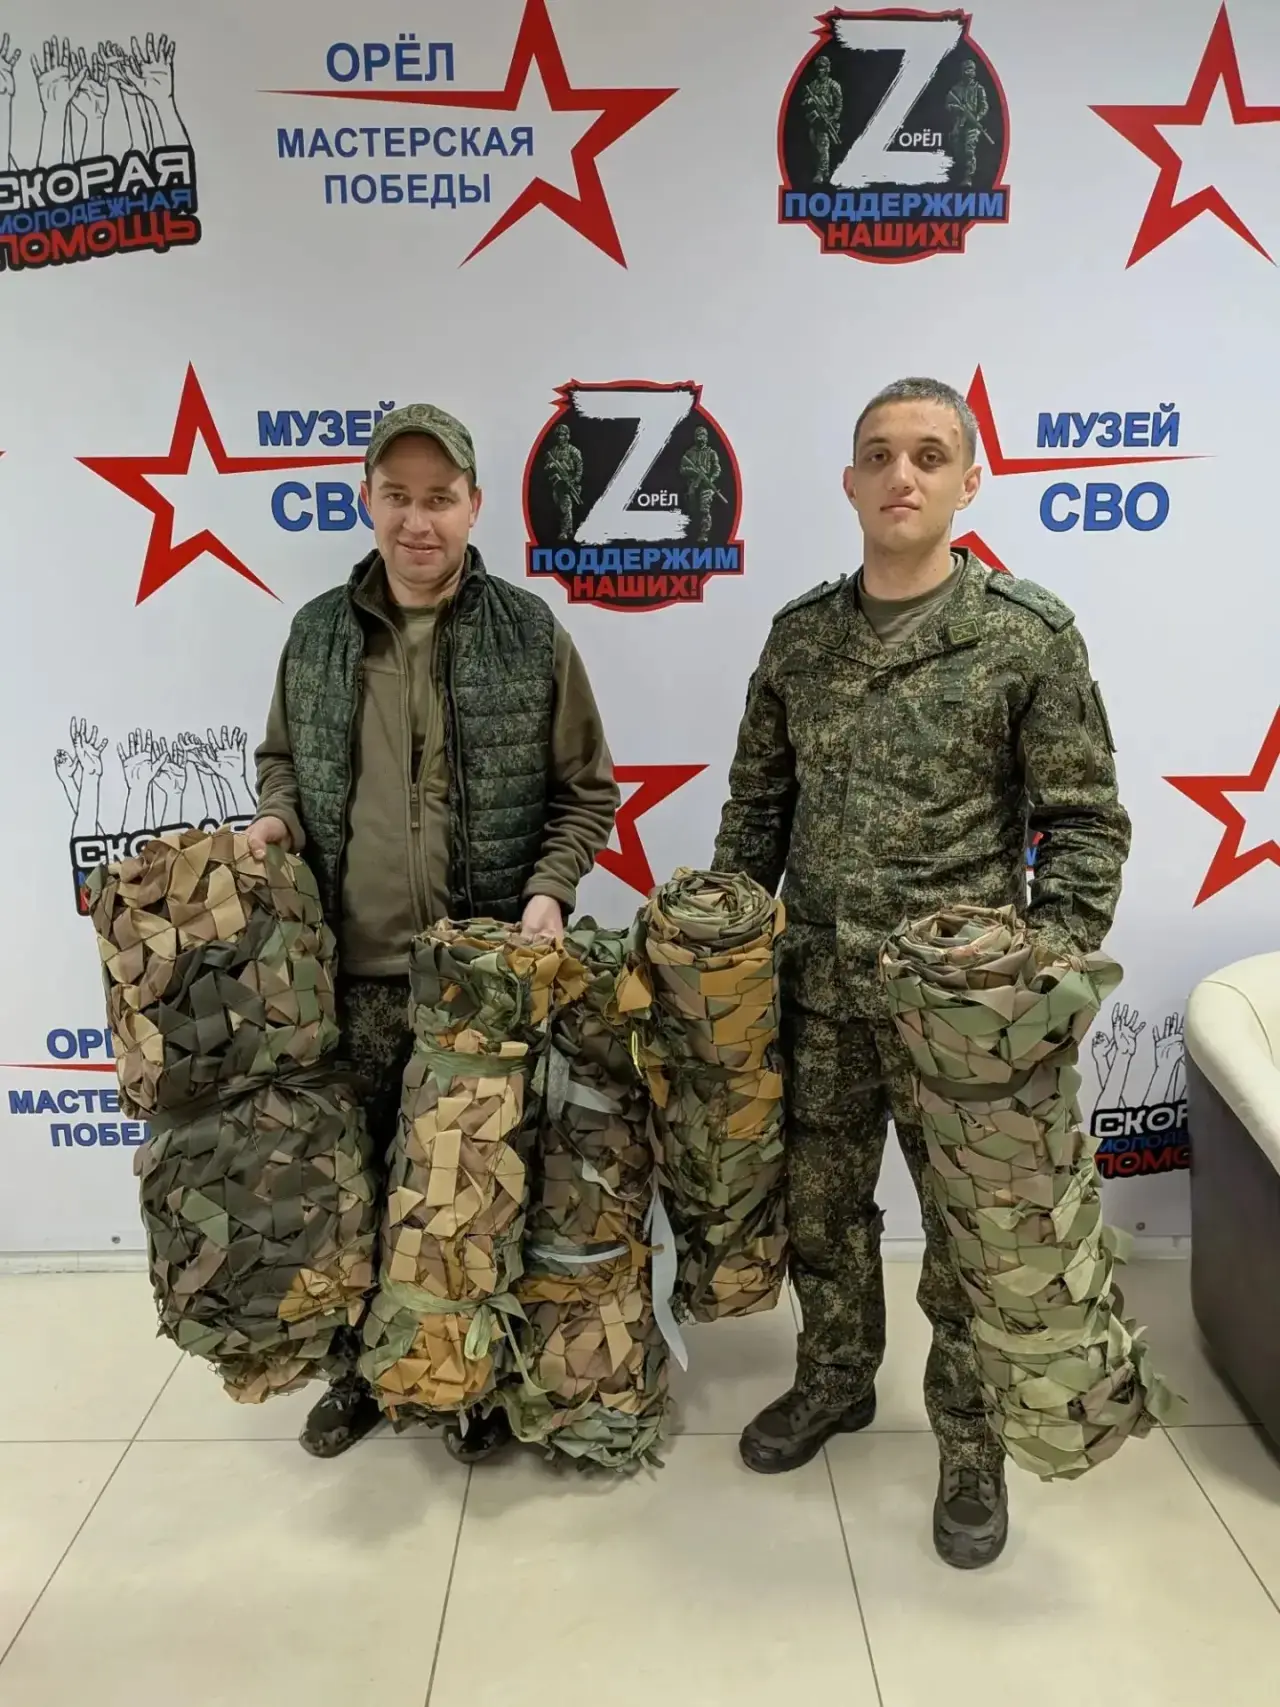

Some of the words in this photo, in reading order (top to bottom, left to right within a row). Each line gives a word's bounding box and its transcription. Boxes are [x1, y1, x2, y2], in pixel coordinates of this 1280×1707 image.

[326, 33, 455, 82] ОРЁЛ
[277, 126, 534, 158] МАСТЕРСКАЯ
[899, 129, 942, 147] ОРЁЛ
[324, 173, 491, 209] ПОБЕДЫ
[785, 191, 1004, 221] ПОДДЕРЖИМ
[827, 223, 959, 248] НАШИХ!
[1036, 402, 1180, 448] МУЗЕЙ
[637, 489, 678, 508] ОРЁЛ
[1039, 481, 1170, 533] СВО
[532, 547, 738, 575] ПОДДЕРЖИМ
[573, 574, 699, 598] НАШИХ!
